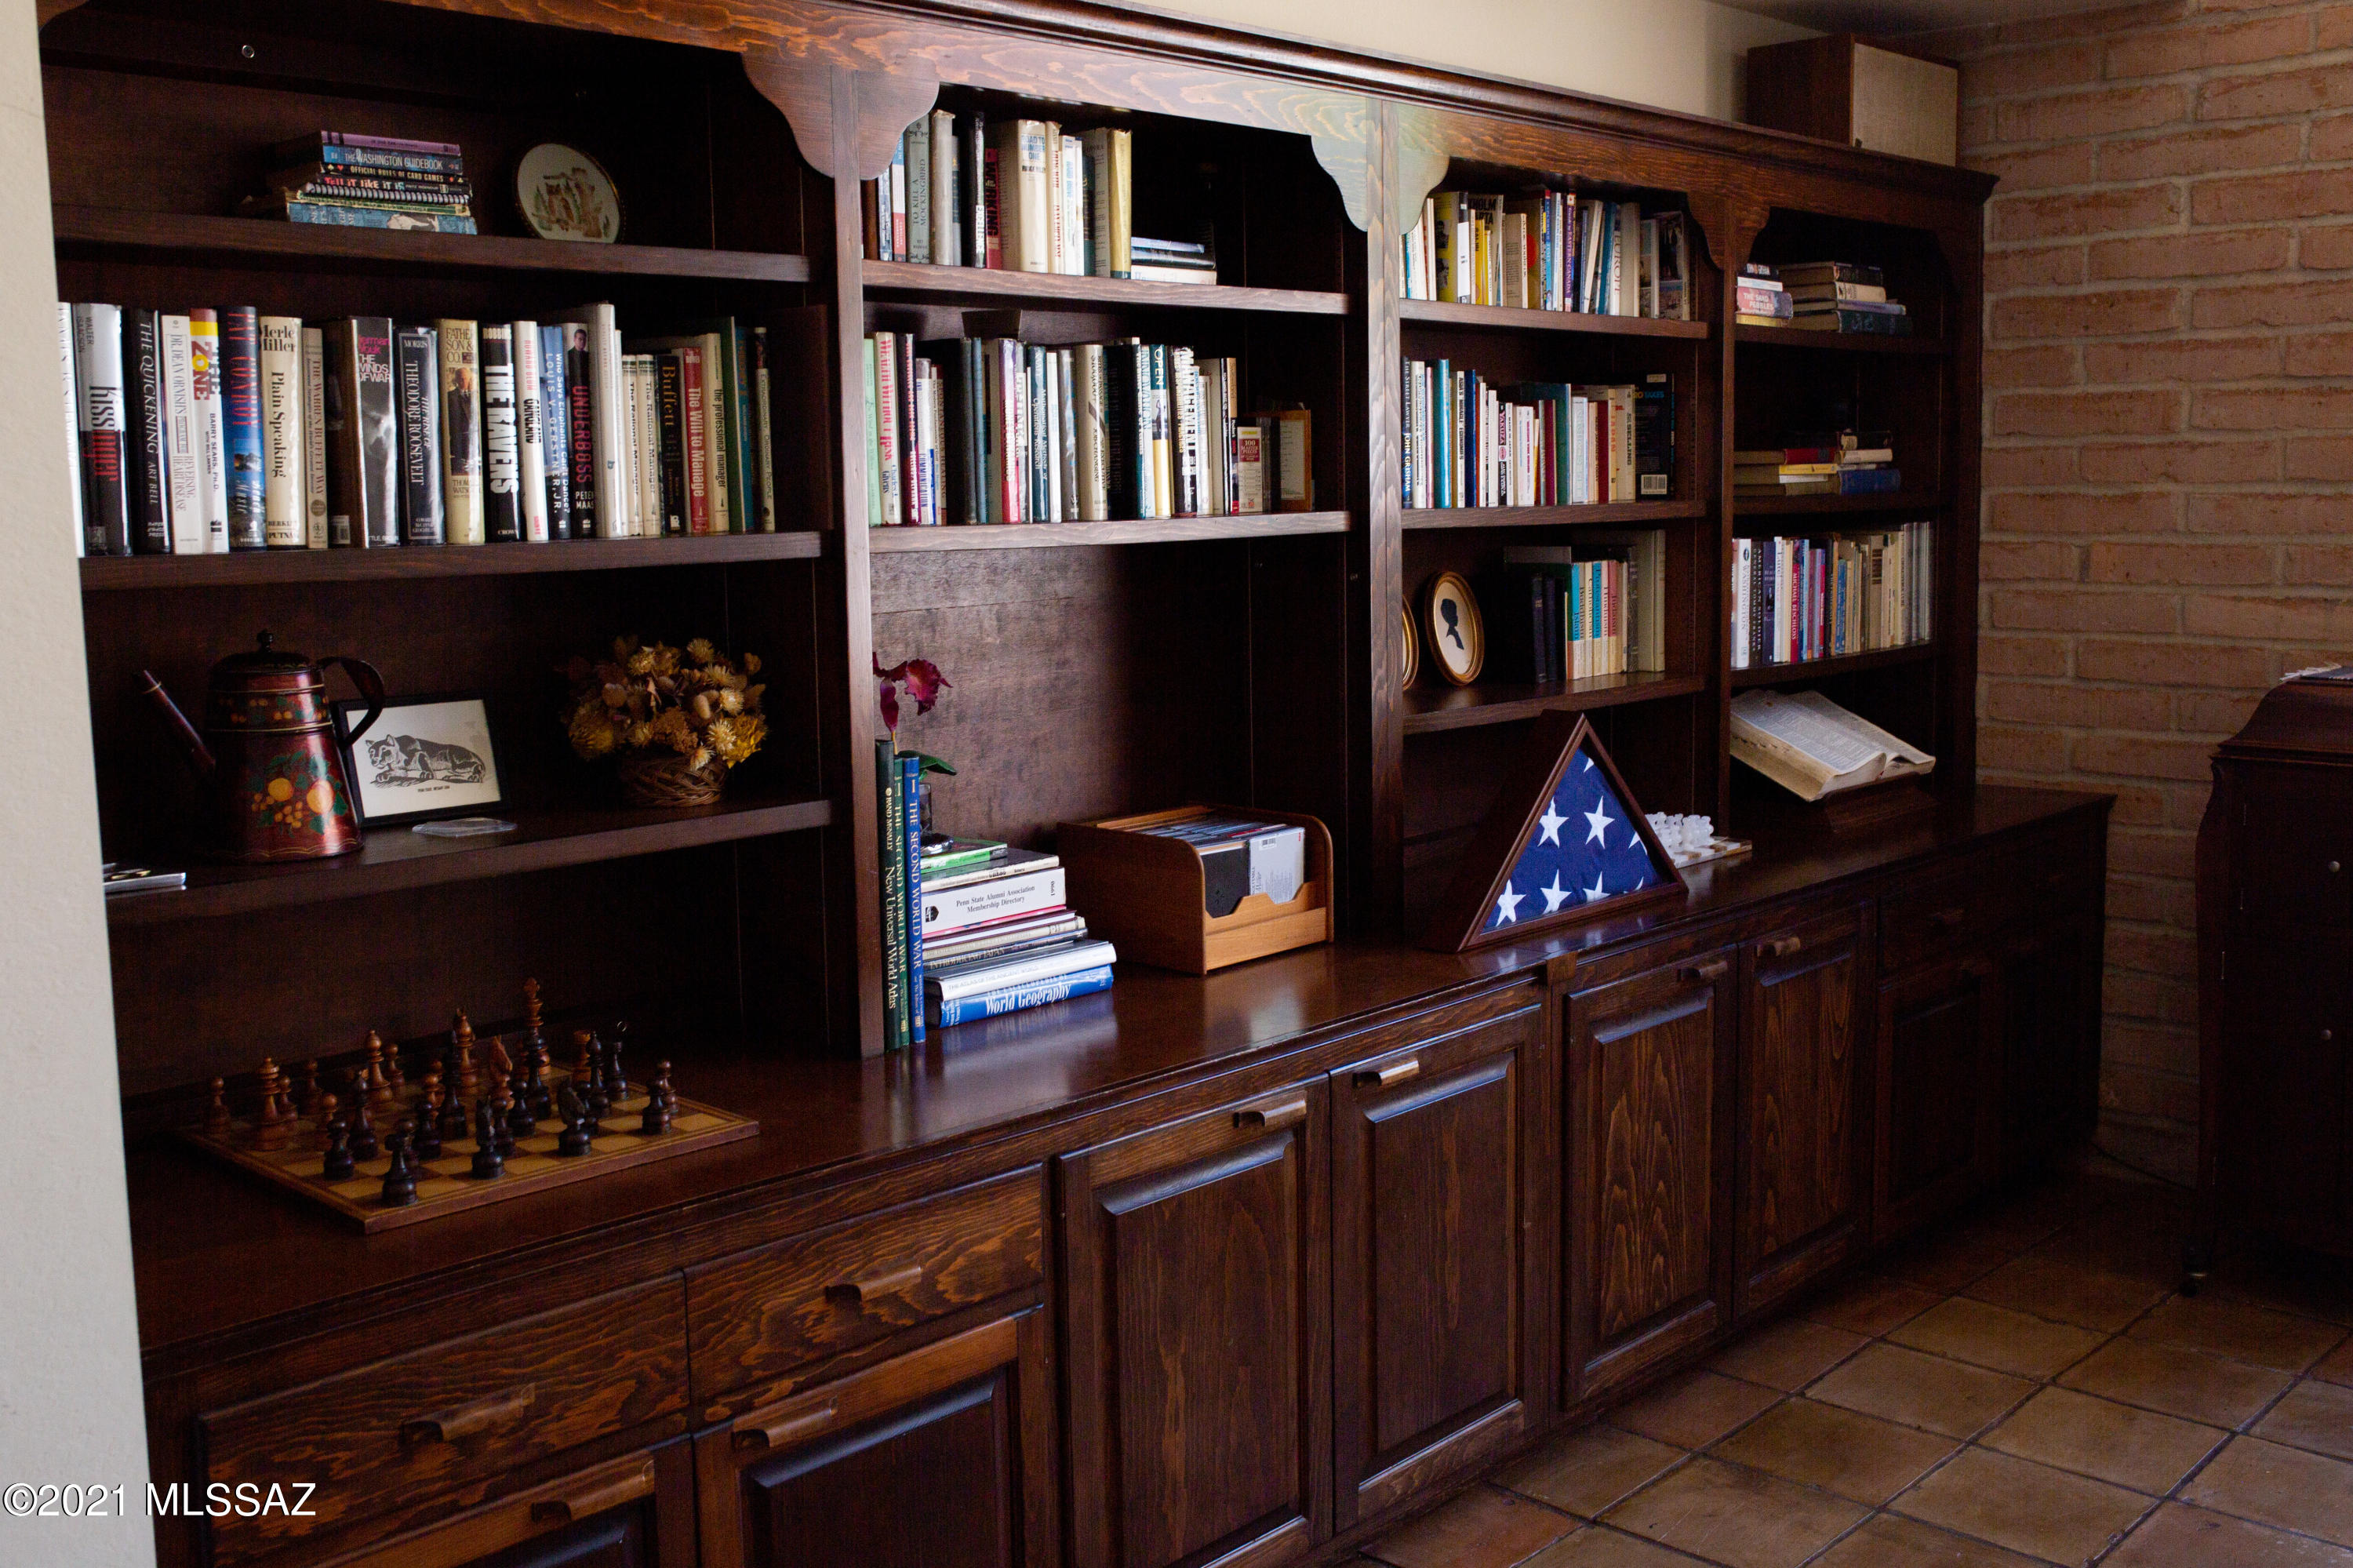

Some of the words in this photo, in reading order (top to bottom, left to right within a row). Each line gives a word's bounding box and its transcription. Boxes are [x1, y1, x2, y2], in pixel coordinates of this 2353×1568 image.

[345, 153, 356, 162] THE
[356, 154, 402, 167] WASHINGTON
[404, 158, 443, 170] GUIDEBOOK
[351, 166, 376, 175] OFFICIAL
[407, 170, 421, 180] CARD
[424, 173, 444, 182] GAMES
[985, 162, 998, 236] WORKING
[1749, 300, 1774, 311] PEBBLES
[140, 322, 153, 351] THE
[227, 313, 258, 344] PAT
[446, 340, 465, 351] SON
[172, 350, 184, 373] DEAN
[192, 340, 210, 400] ZONE
[313, 359, 322, 380] THE
[546, 353, 555, 392] LOUIS
[879, 340, 893, 382] WEALTH
[1154, 347, 1164, 385] OPEN
[231, 356, 260, 428] CONROY
[271, 372, 286, 408] Plain
[402, 361, 422, 421] THEODORE
[484, 363, 515, 402] THE
[662, 366, 677, 427] Buffett
[688, 387, 701, 408] The
[715, 388, 724, 402] the
[140, 355, 158, 454] QUICKENING
[313, 383, 322, 426] WARREN
[882, 385, 894, 431] WITHOUT
[1180, 351, 1195, 451] MANAGEMENT
[209, 413, 218, 438] BARRY
[524, 398, 540, 444] GANGLAND
[572, 386, 591, 483] UNDERBOSS
[689, 410, 702, 433] Will
[713, 404, 726, 452] professional
[270, 412, 286, 478] Speaking
[409, 424, 424, 486] ROOSEVELT
[486, 407, 518, 494] RAVENS
[691, 436, 702, 446] to
[880, 436, 894, 461] RISK
[147, 461, 157, 480] ART
[315, 476, 325, 495] WAY
[647, 448, 656, 493] Manager
[690, 450, 705, 497] Manage
[715, 454, 726, 488] manager
[919, 453, 928, 508] COMMUNICATION
[149, 483, 158, 505] BELL
[909, 800, 919, 827] THE
[910, 831, 920, 882] SECOND
[884, 866, 896, 893] New
[956, 899, 969, 908] Penn
[971, 896, 984, 905] State
[986, 891, 1006, 901] Alumni
[1006, 885, 1035, 898] Association
[911, 886, 921, 937] WORLD
[967, 902, 1000, 913] Membership
[1001, 895, 1025, 907] Directory
[886, 897, 898, 946] Universal
[887, 949, 898, 980] World
[898, 942, 907, 973] WAR
[912, 940, 922, 970] WAR
[888, 982, 899, 1010] Atlas
[985, 992, 1015, 1016] World
[1018, 984, 1071, 1007] Geography
